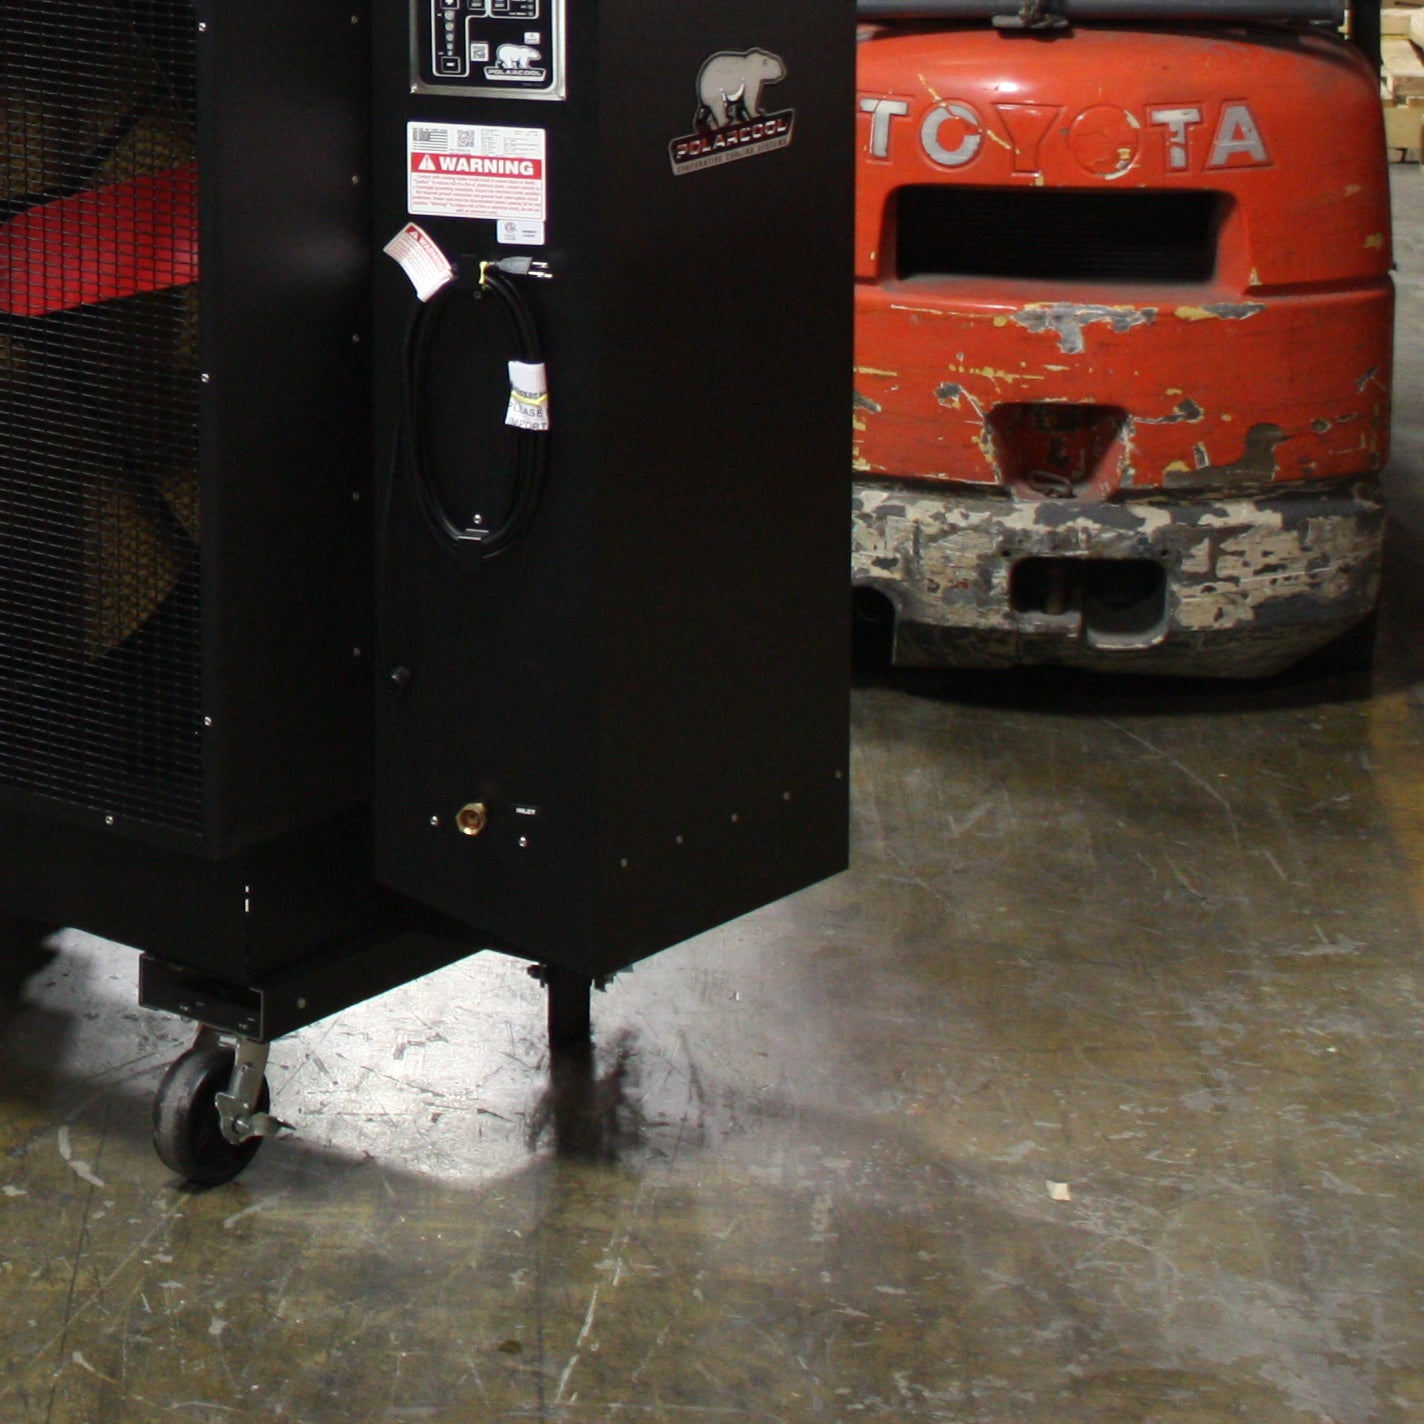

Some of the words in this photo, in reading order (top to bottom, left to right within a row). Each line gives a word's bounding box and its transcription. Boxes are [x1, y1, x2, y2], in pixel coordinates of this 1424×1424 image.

[488, 68, 542, 76] POLARCOOL
[675, 117, 788, 160] POLARCOOL
[860, 98, 1273, 178] TOYOTA
[438, 156, 534, 176] WARNING
